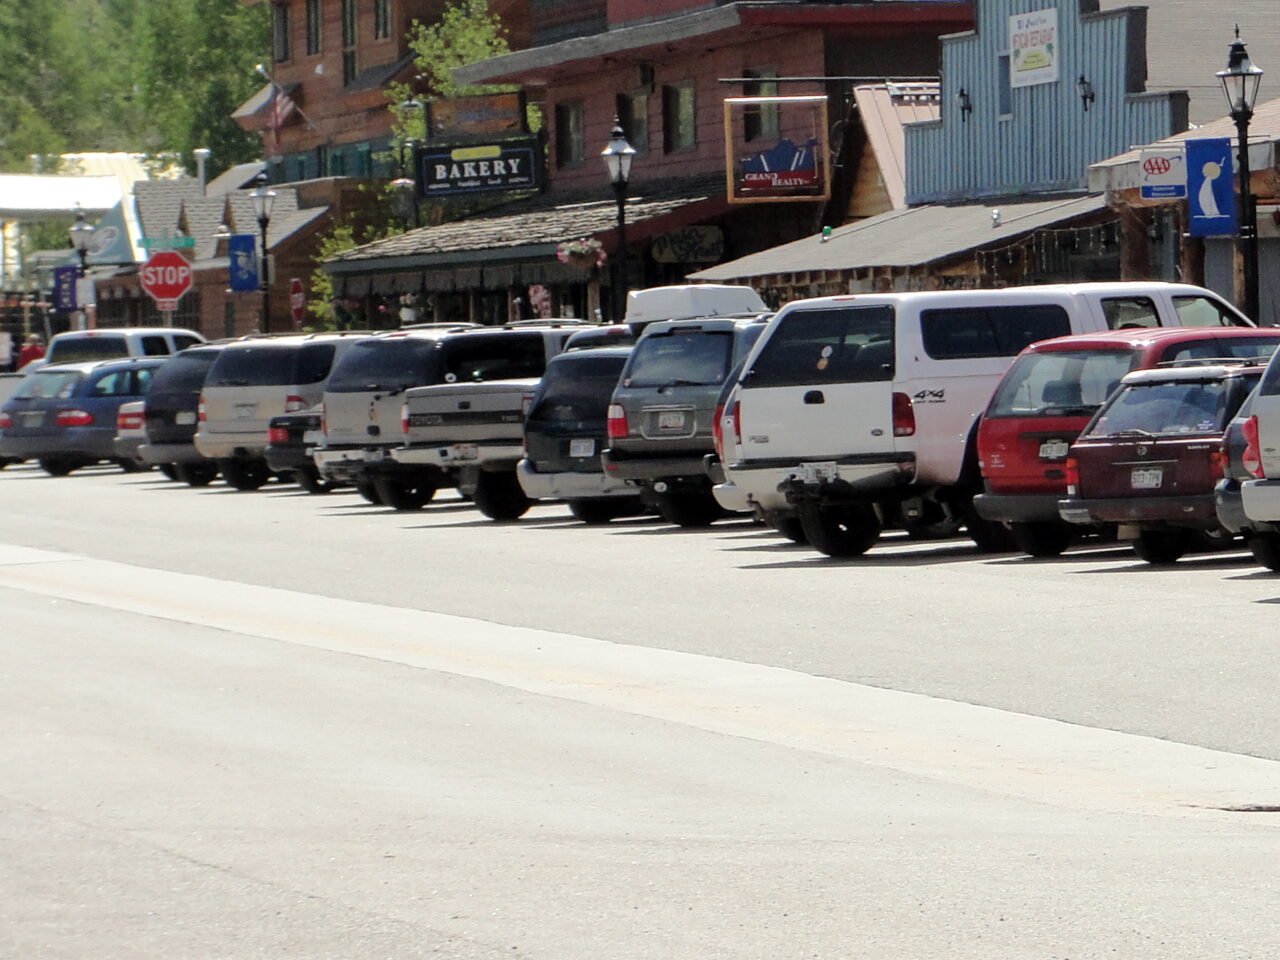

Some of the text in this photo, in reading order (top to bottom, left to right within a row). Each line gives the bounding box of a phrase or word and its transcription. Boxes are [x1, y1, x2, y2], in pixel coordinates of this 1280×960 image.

[435, 159, 520, 180] BAKERY
[1144, 157, 1169, 174] AAA
[745, 172, 778, 180] GRAND
[144, 266, 190, 285] STOP
